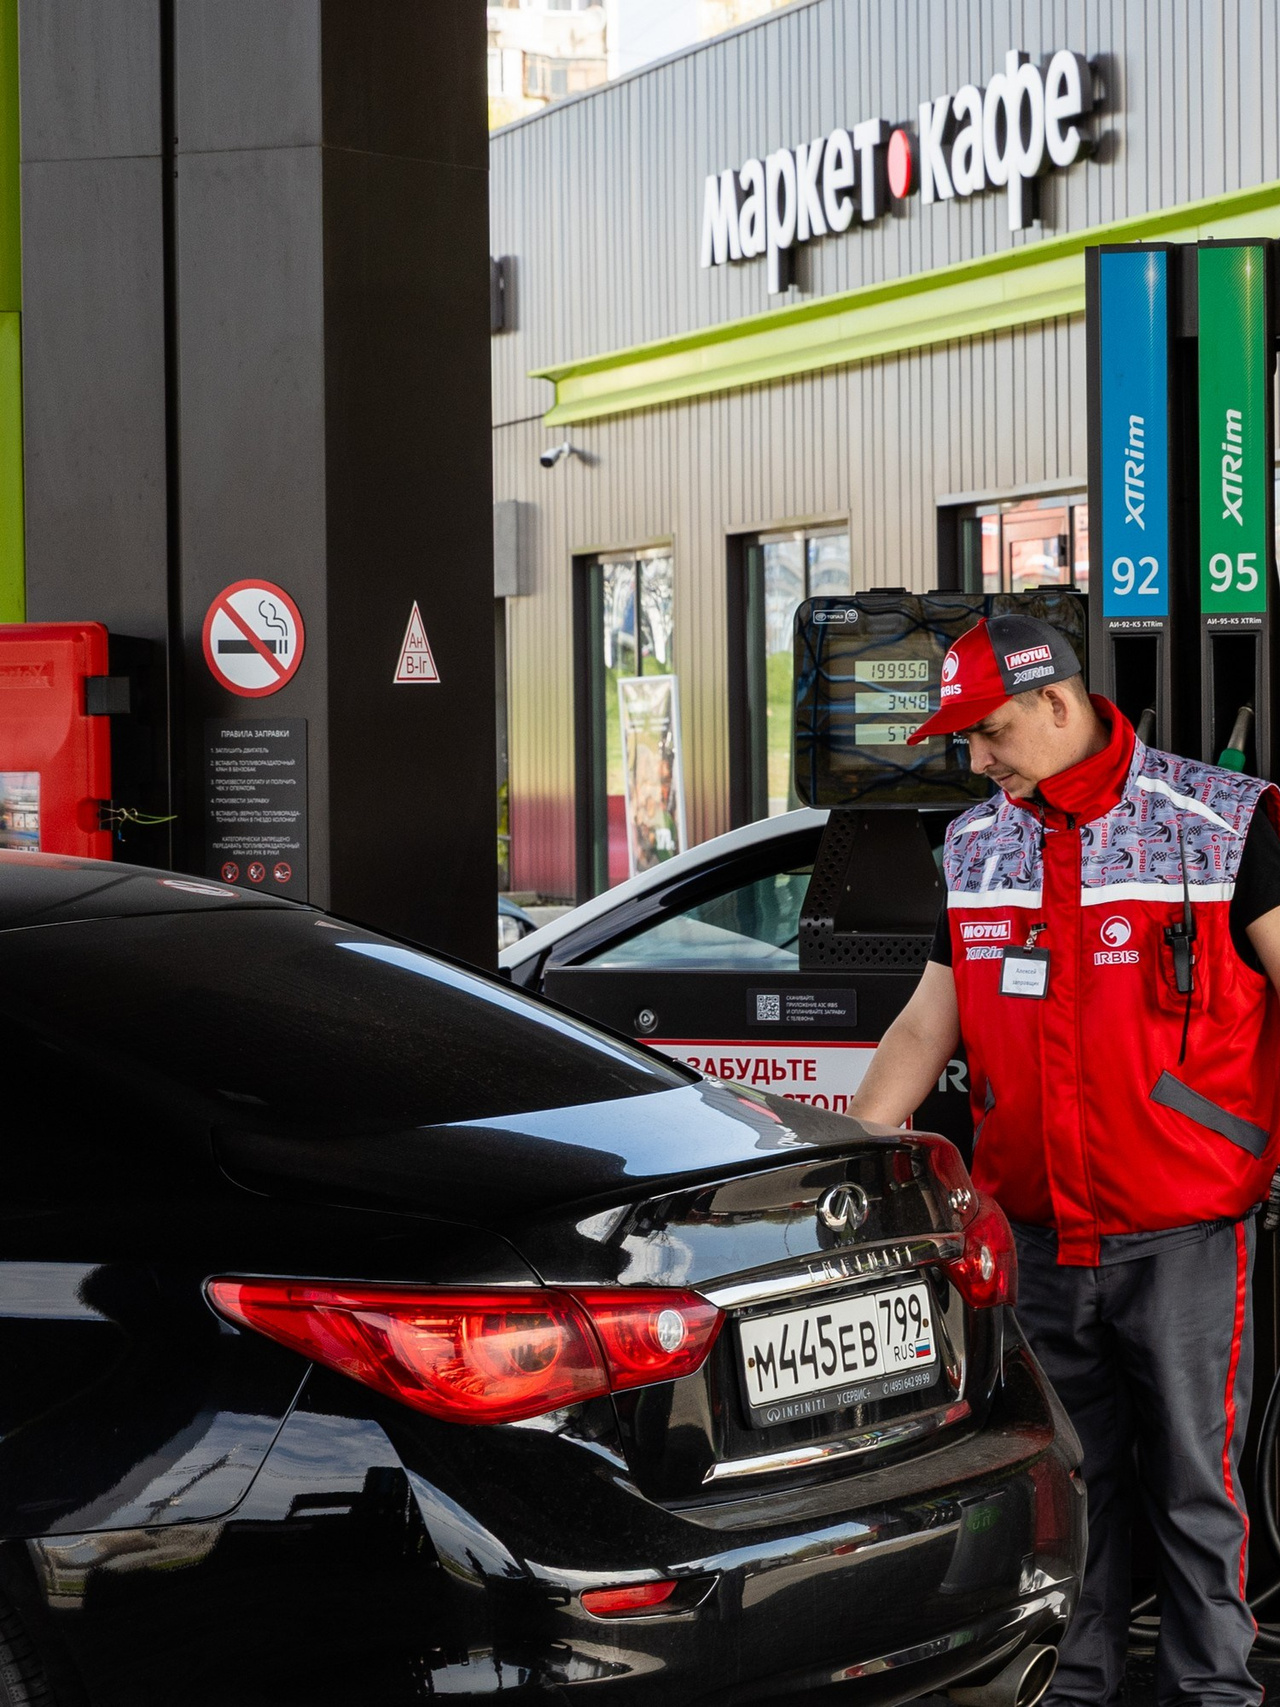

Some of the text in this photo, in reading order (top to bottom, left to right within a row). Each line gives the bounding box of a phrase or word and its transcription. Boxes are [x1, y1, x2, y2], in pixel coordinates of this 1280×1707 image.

[701, 48, 1083, 295] маркет кафе
[1125, 414, 1146, 531] XTRim
[1221, 408, 1244, 527] XTRim
[1111, 555, 1160, 596] 92
[1208, 552, 1259, 593] 95
[1142, 620, 1163, 628] XTRim
[1241, 617, 1262, 625] XTRim
[1010, 647, 1049, 667] MOTUL
[872, 662, 927, 679] 1999.50
[1013, 665, 1055, 685] XTRim
[940, 684, 962, 698] RBIS
[888, 694, 928, 711] 34.48
[221, 730, 290, 738] ПРАВИЛА ЗАПРАВКИ
[963, 924, 1007, 939] MOTUL
[1094, 950, 1139, 966] IRBIS
[754, 1293, 922, 1393] М445ЕВ 799
[894, 1343, 915, 1363] RUS
[782, 1398, 826, 1419] INFINITI
